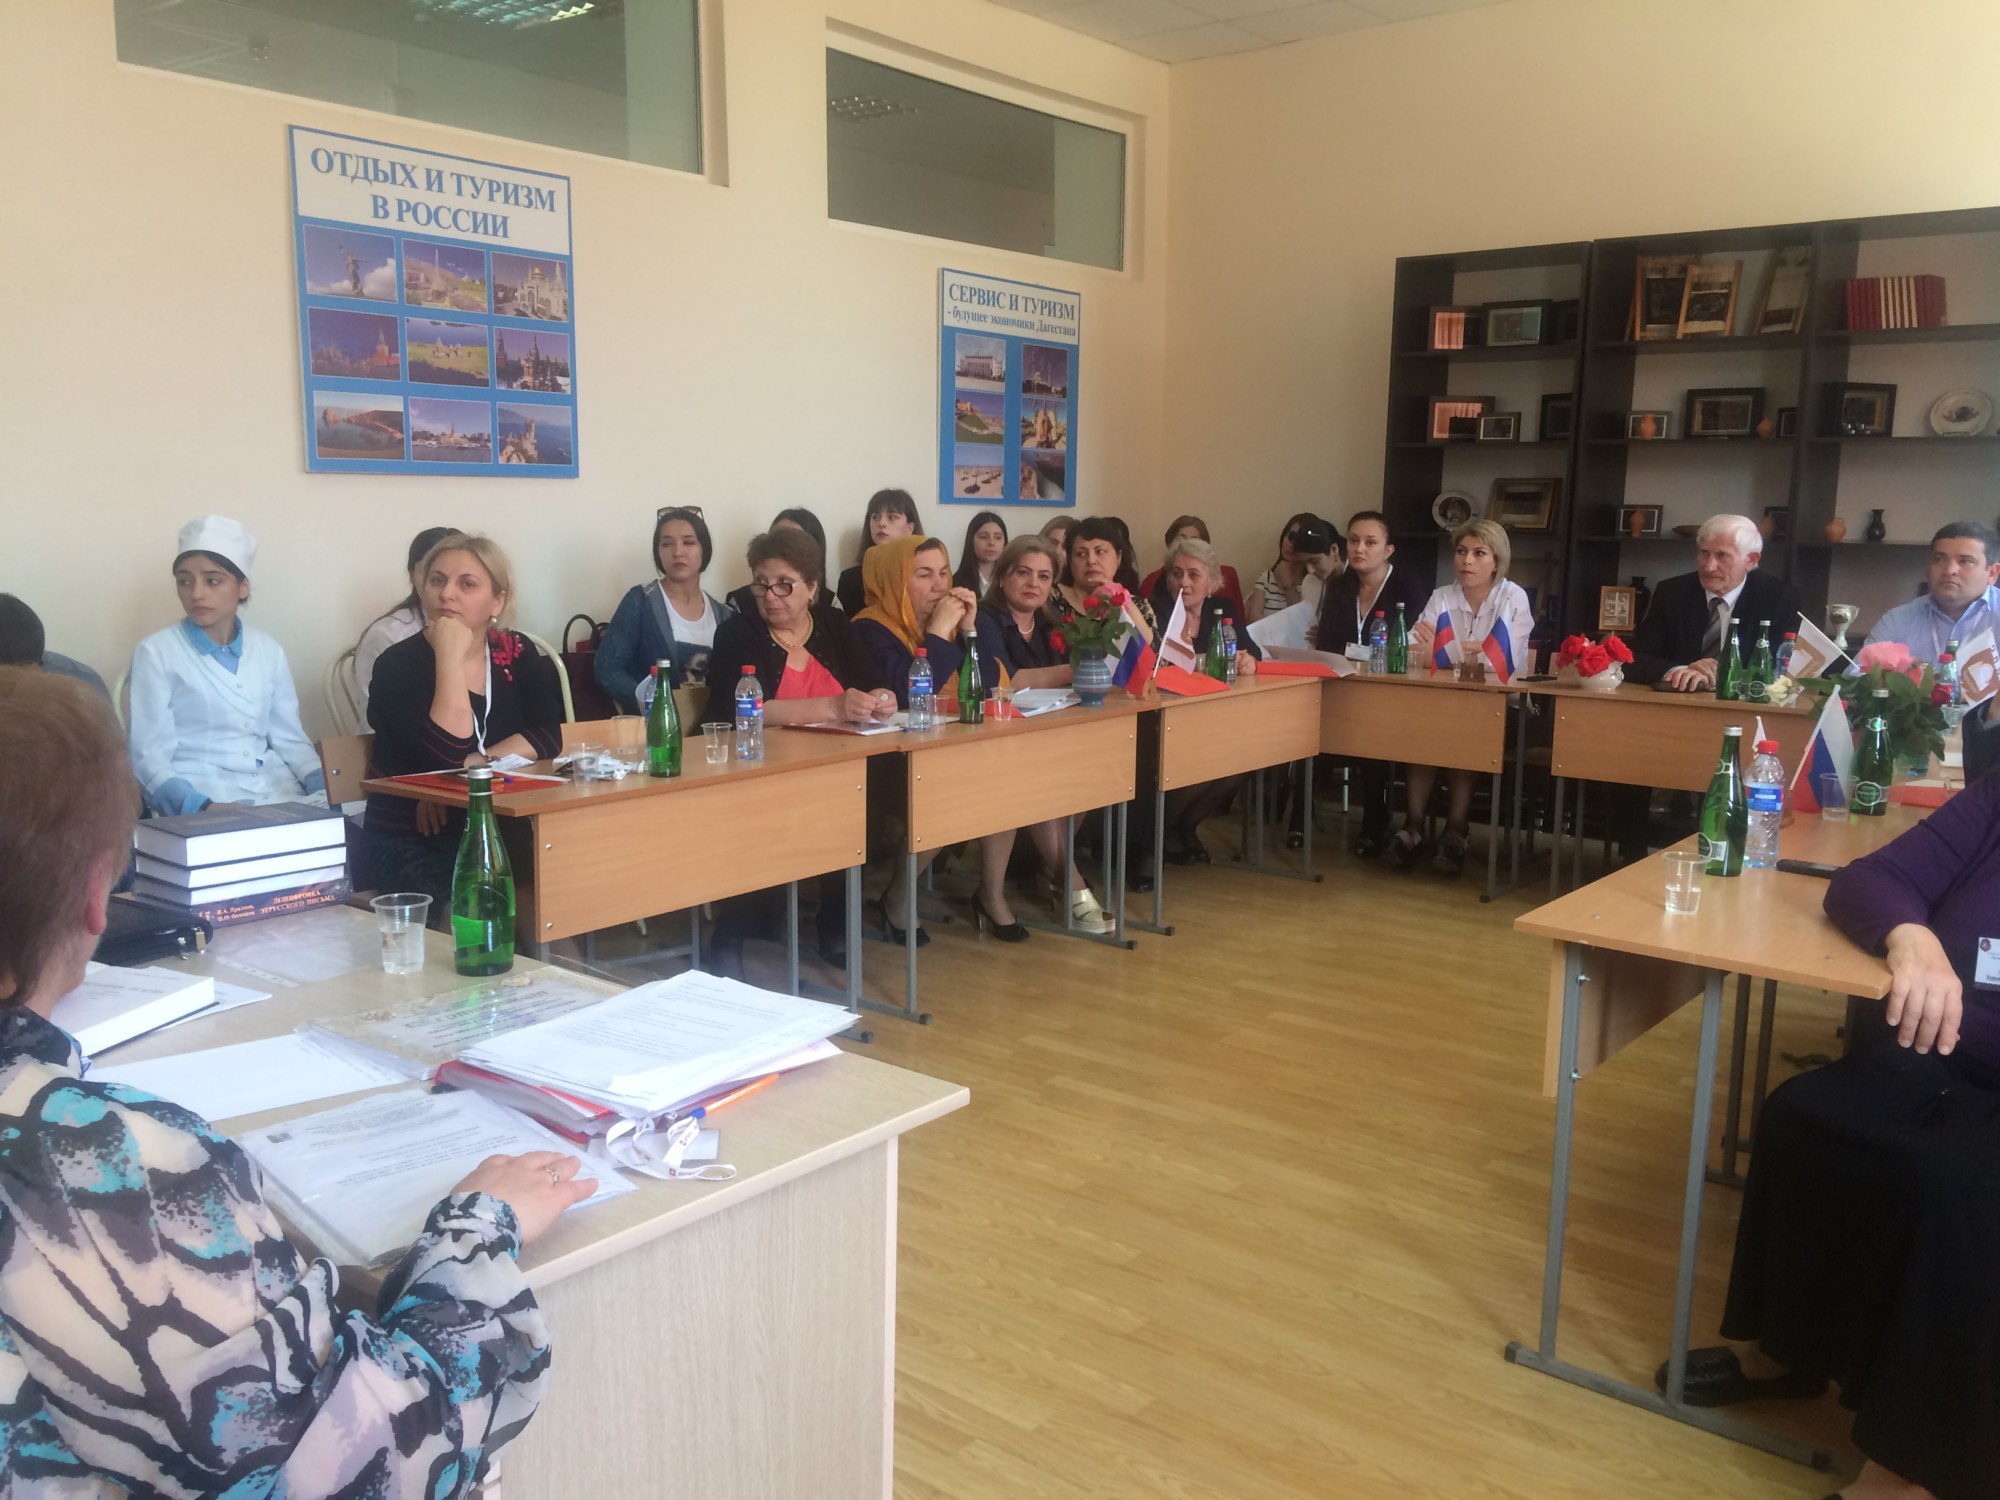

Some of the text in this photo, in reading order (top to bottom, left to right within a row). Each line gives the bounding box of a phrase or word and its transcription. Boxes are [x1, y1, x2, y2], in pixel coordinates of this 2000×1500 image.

[310, 147, 556, 213] ОТДЫХ И ТУРИЗМ
[370, 194, 510, 239] В РОССИИ
[949, 284, 1076, 321] СЕРВИС И ТУРИЗМ
[953, 306, 989, 324] будущее
[990, 314, 1035, 331] экономики
[1036, 319, 1076, 337] Дагестана
[260, 900, 305, 914] ЭТРУССКОГО
